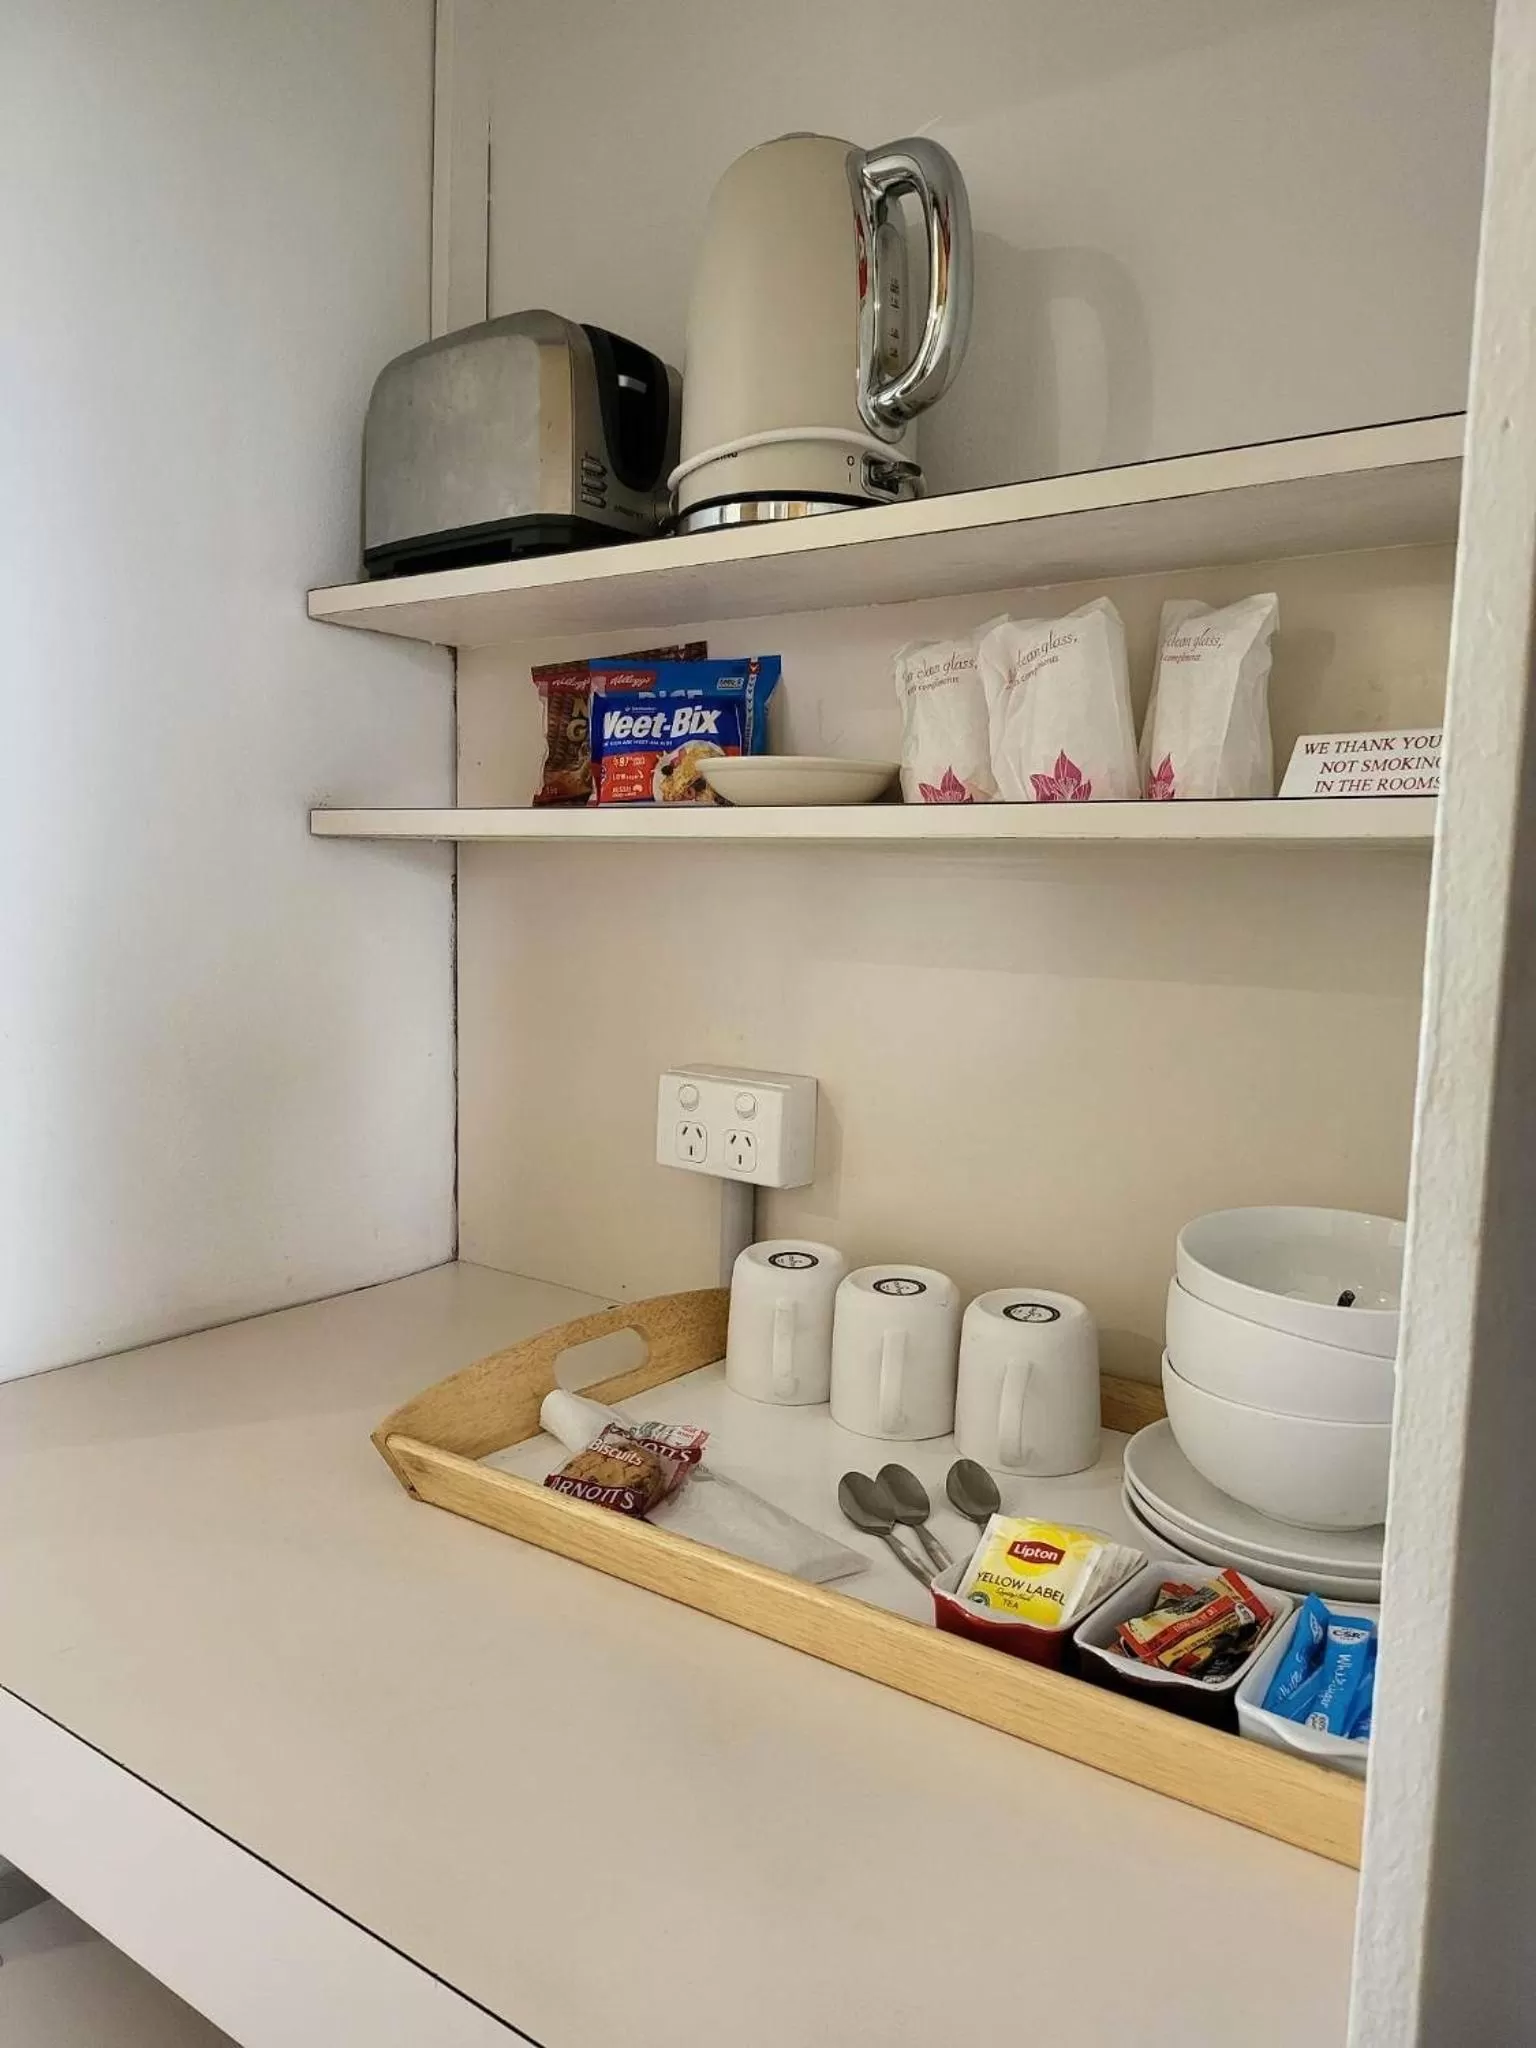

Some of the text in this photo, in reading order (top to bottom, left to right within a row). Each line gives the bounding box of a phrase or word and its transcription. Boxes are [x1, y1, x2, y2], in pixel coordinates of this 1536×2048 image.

[1305, 742, 1329, 755] WE
[1334, 737, 1396, 753] THANK
[1320, 760, 1357, 774] NOT
[1315, 780, 1333, 792] IN
[1339, 779, 1372, 791] THE
[589, 1439, 642, 1466] Biscuits
[1013, 1543, 1058, 1562] Lipton
[977, 1571, 1025, 1590] YELLOW
[1026, 1583, 1066, 1606] LABEL
[1002, 1599, 1018, 1609] TEA
